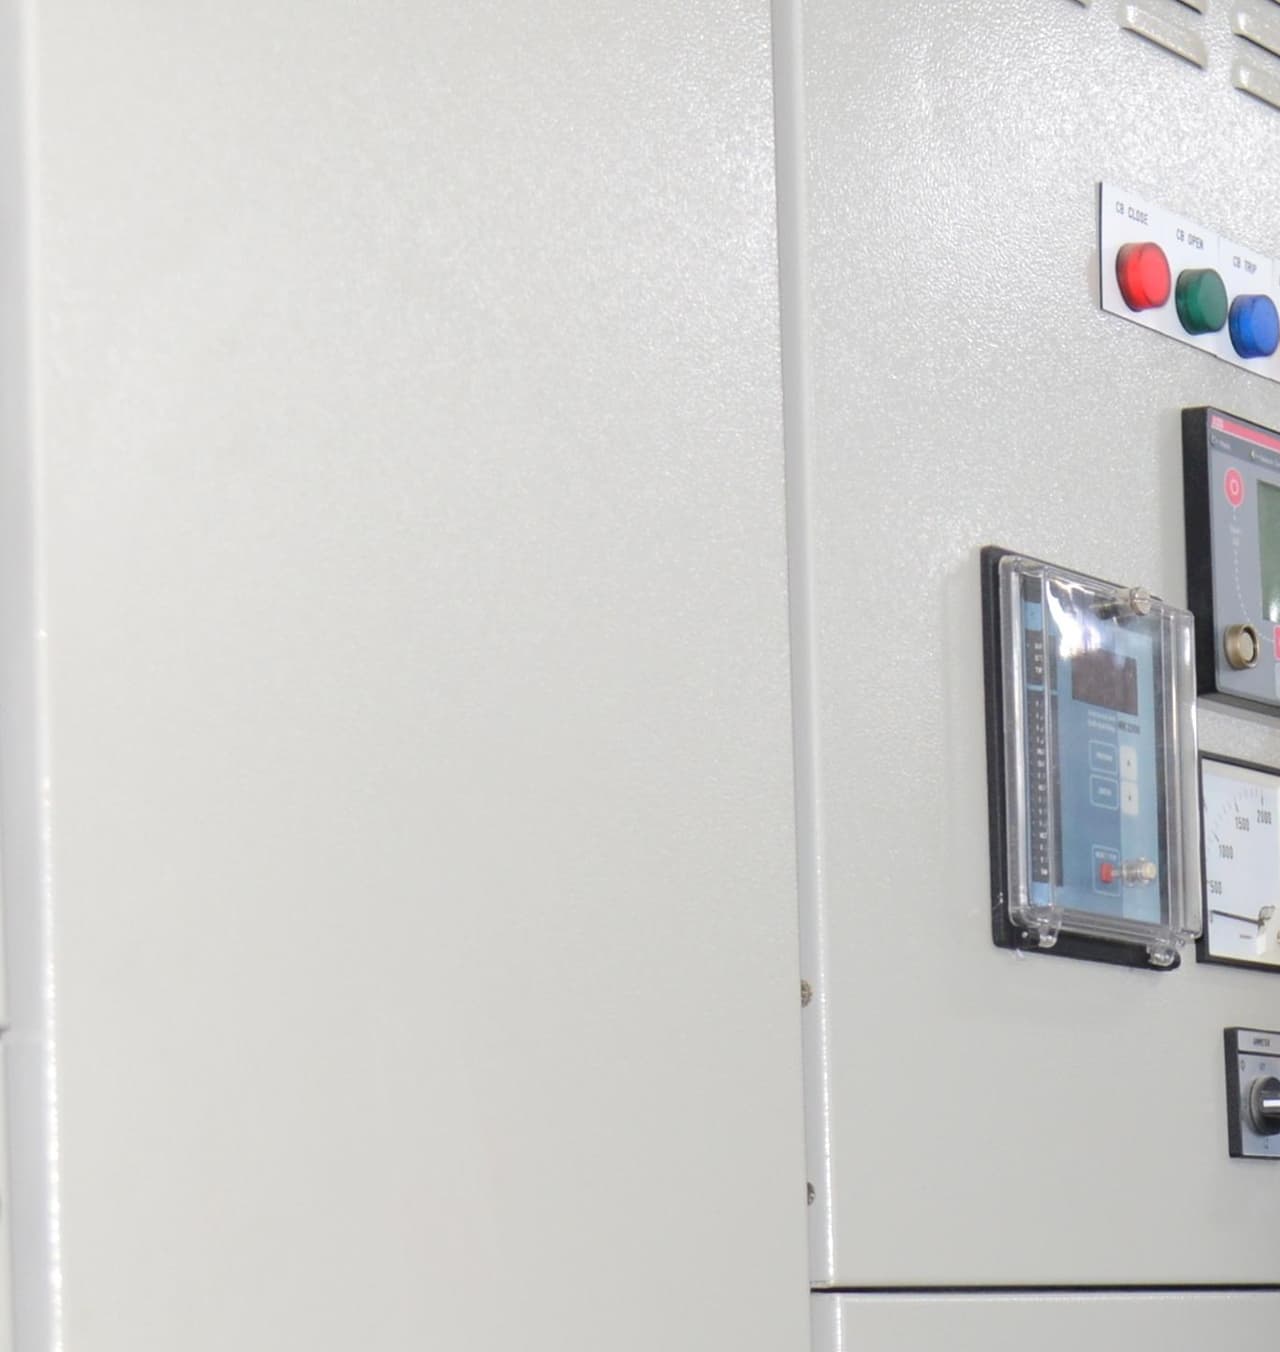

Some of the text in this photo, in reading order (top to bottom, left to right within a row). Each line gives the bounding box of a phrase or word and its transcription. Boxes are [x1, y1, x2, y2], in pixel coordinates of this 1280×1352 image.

[1128, 206, 1150, 225] CLOSE
[1188, 233, 1204, 249] OPEN
[1234, 816, 1250, 833] 1500
[1256, 809, 1272, 825] 2000
[1218, 844, 1234, 860] 1000
